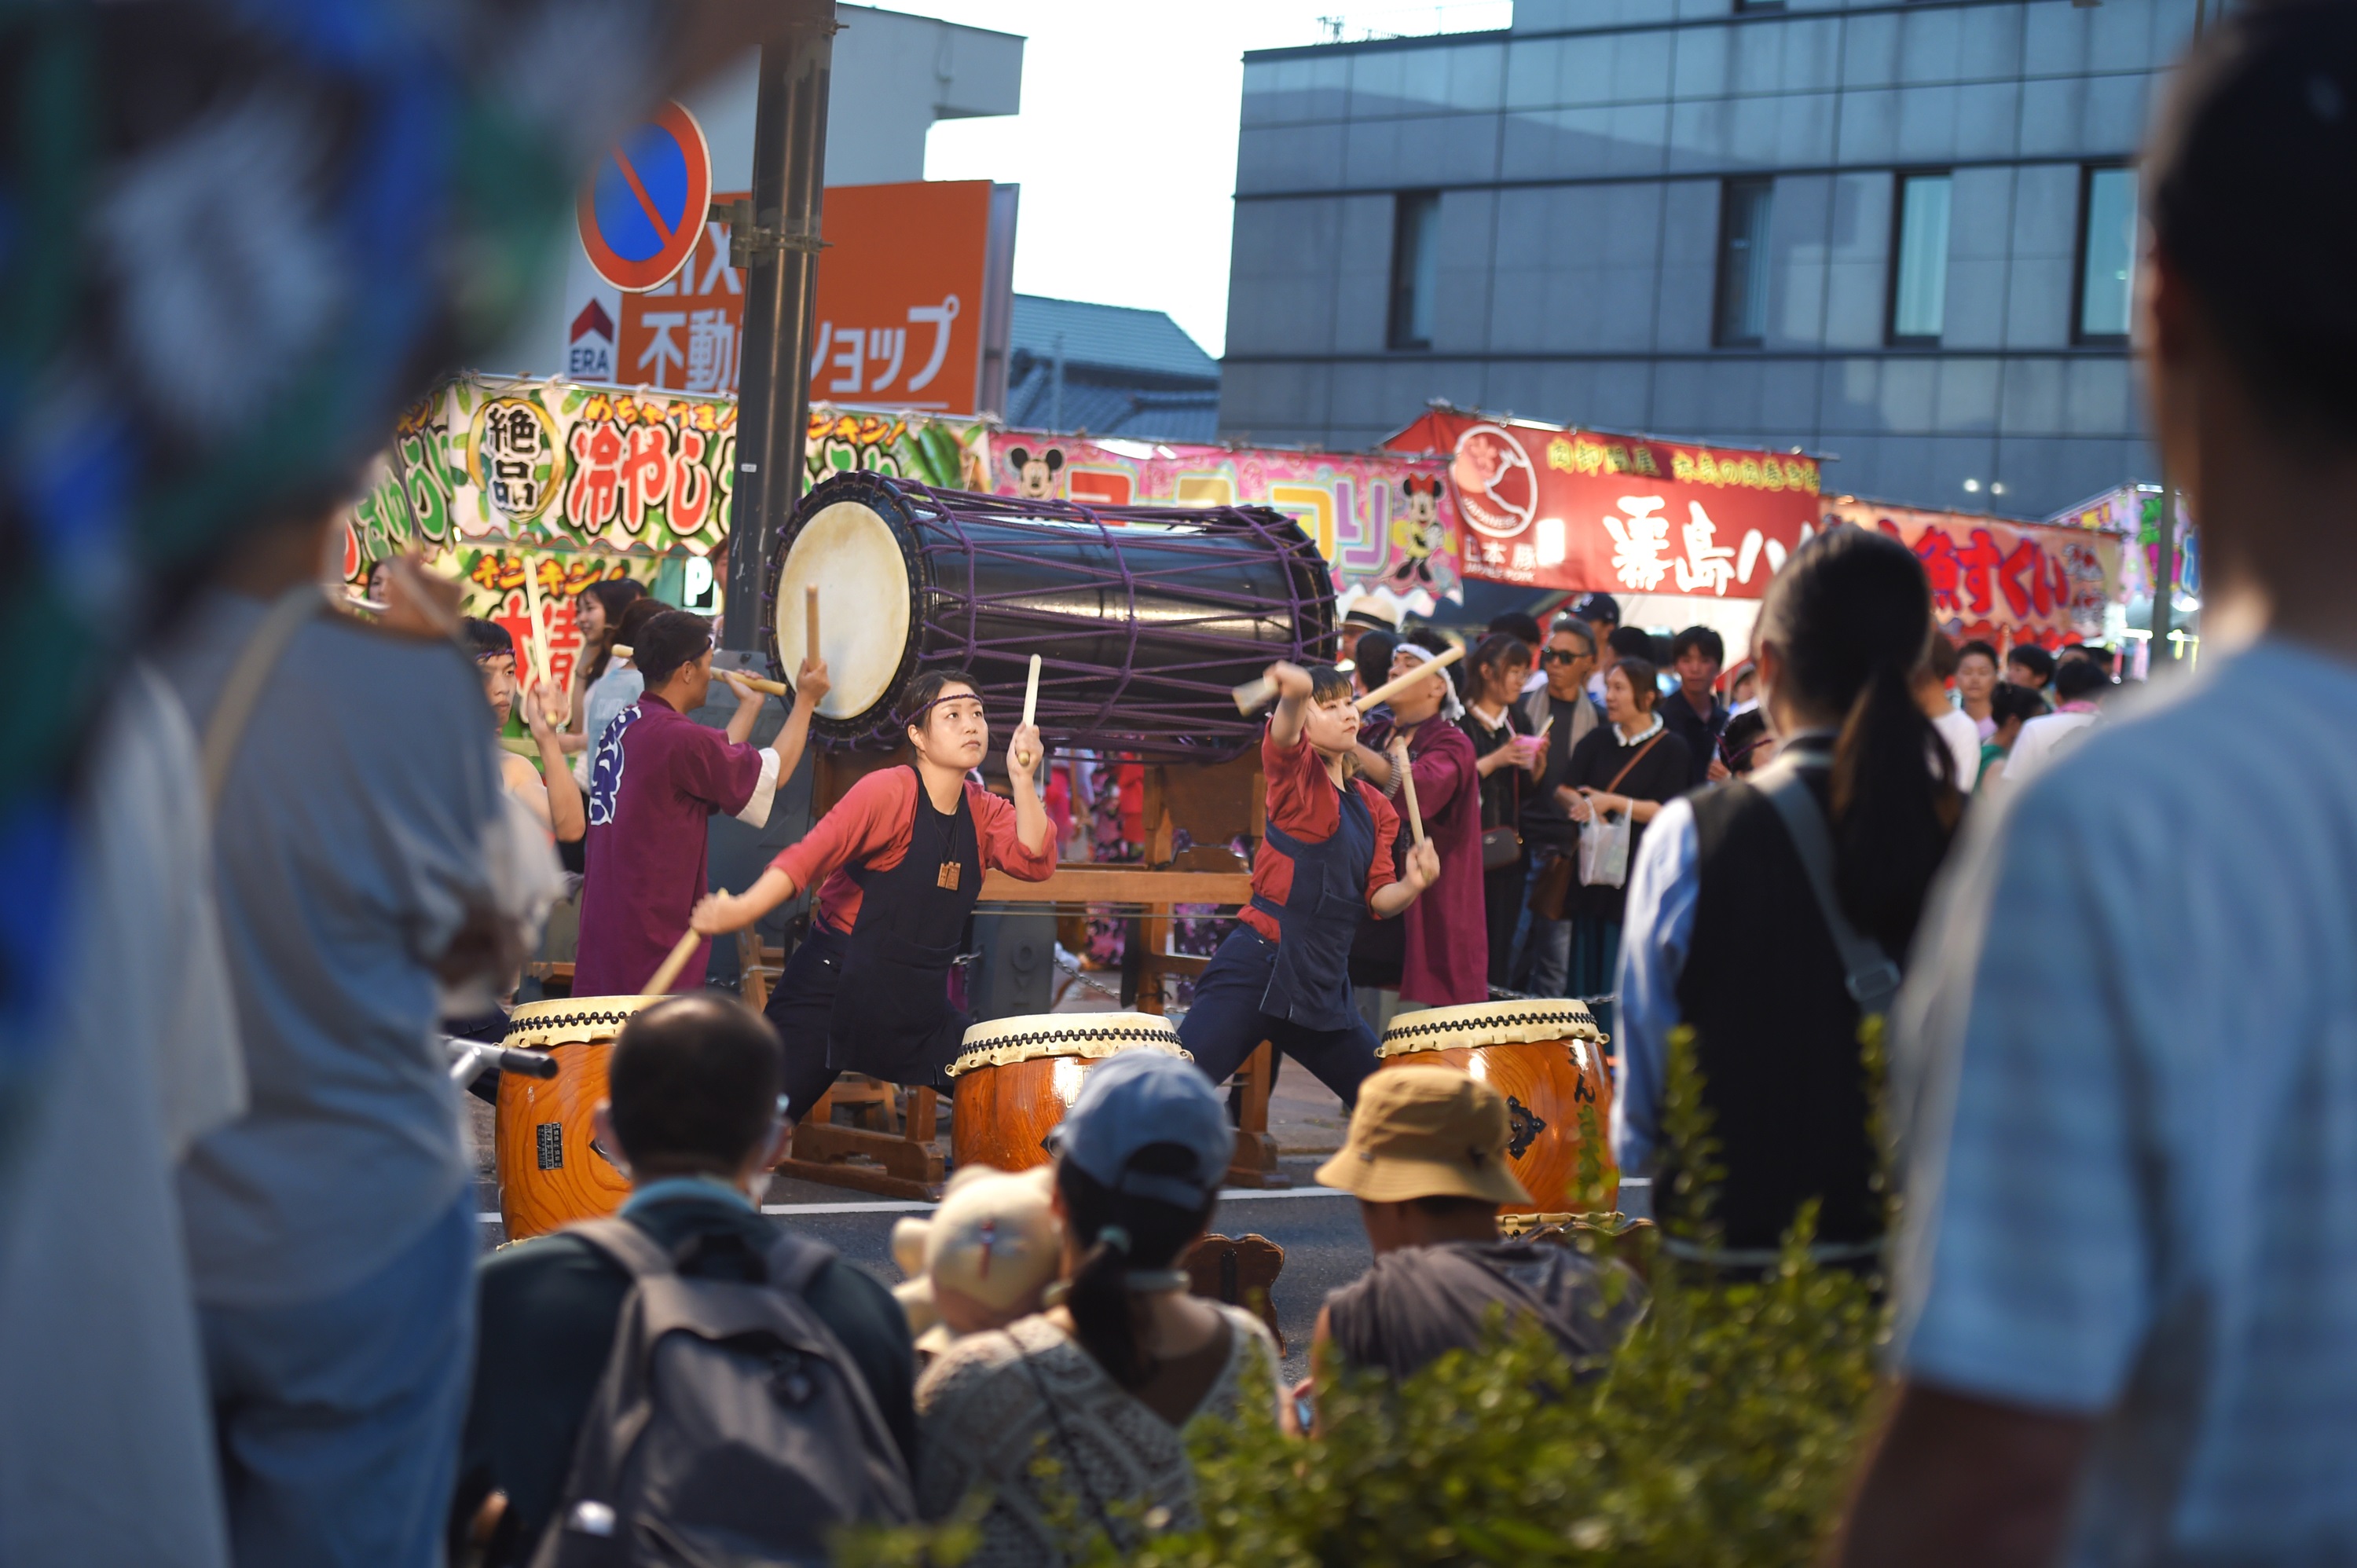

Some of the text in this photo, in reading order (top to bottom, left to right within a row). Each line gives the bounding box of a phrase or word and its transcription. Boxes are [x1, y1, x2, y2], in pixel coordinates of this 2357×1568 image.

[570, 348, 610, 375] ERA
[806, 413, 907, 446] ンキン!
[488, 405, 539, 508] 絶品
[1463, 496, 1518, 529] JAPANESE
[1603, 495, 1816, 598] 霧島ハ
[1878, 518, 2069, 619] 魚すくい
[684, 555, 713, 607] P
